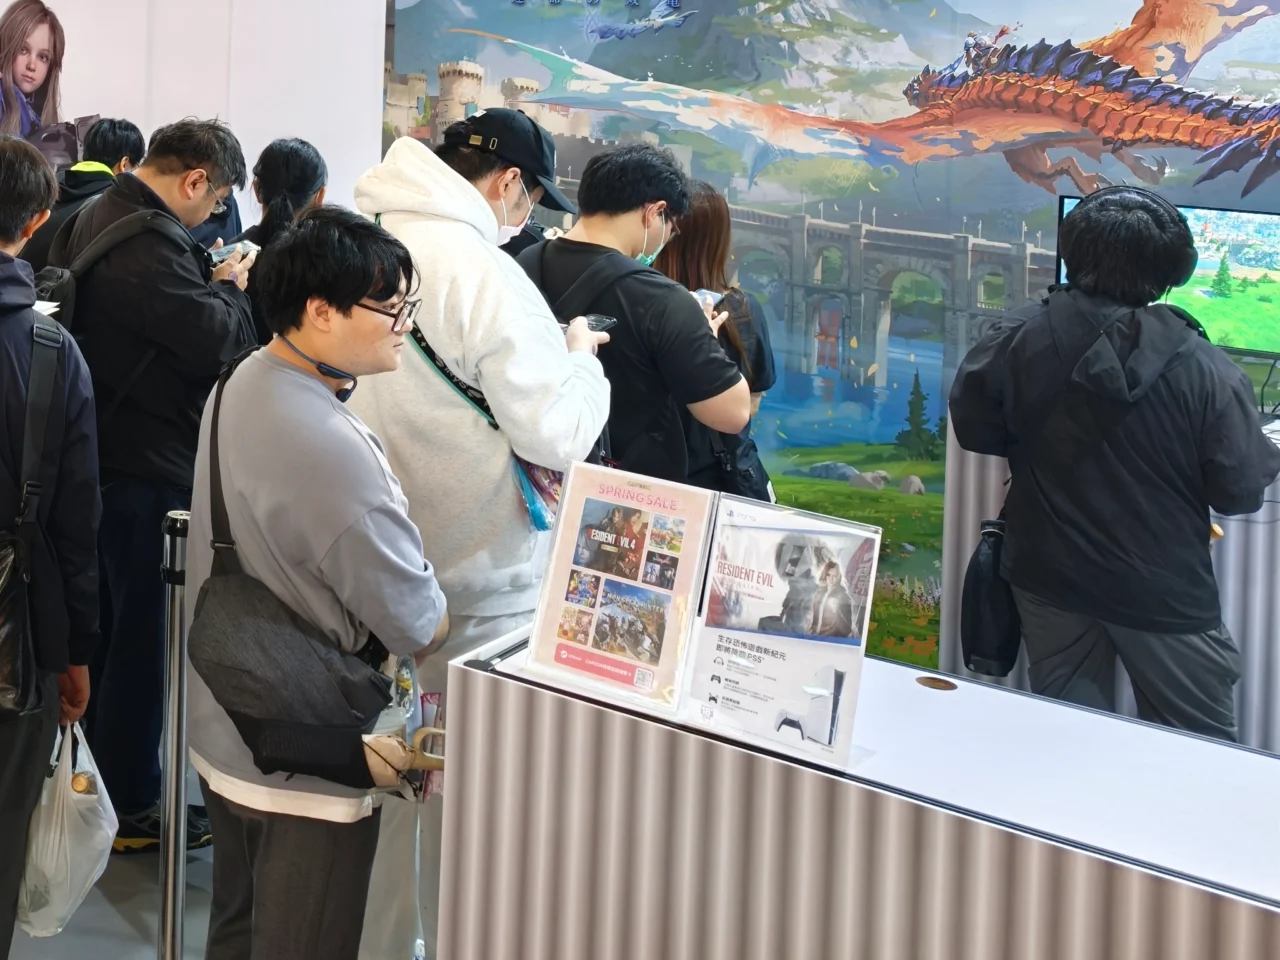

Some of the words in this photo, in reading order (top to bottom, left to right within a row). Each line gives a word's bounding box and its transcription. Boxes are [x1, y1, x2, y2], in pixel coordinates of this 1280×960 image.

[598, 483, 645, 503] SPRING
[646, 494, 679, 511] SALE
[716, 560, 755, 583] RESIDENT
[756, 572, 774, 588] EVIL
